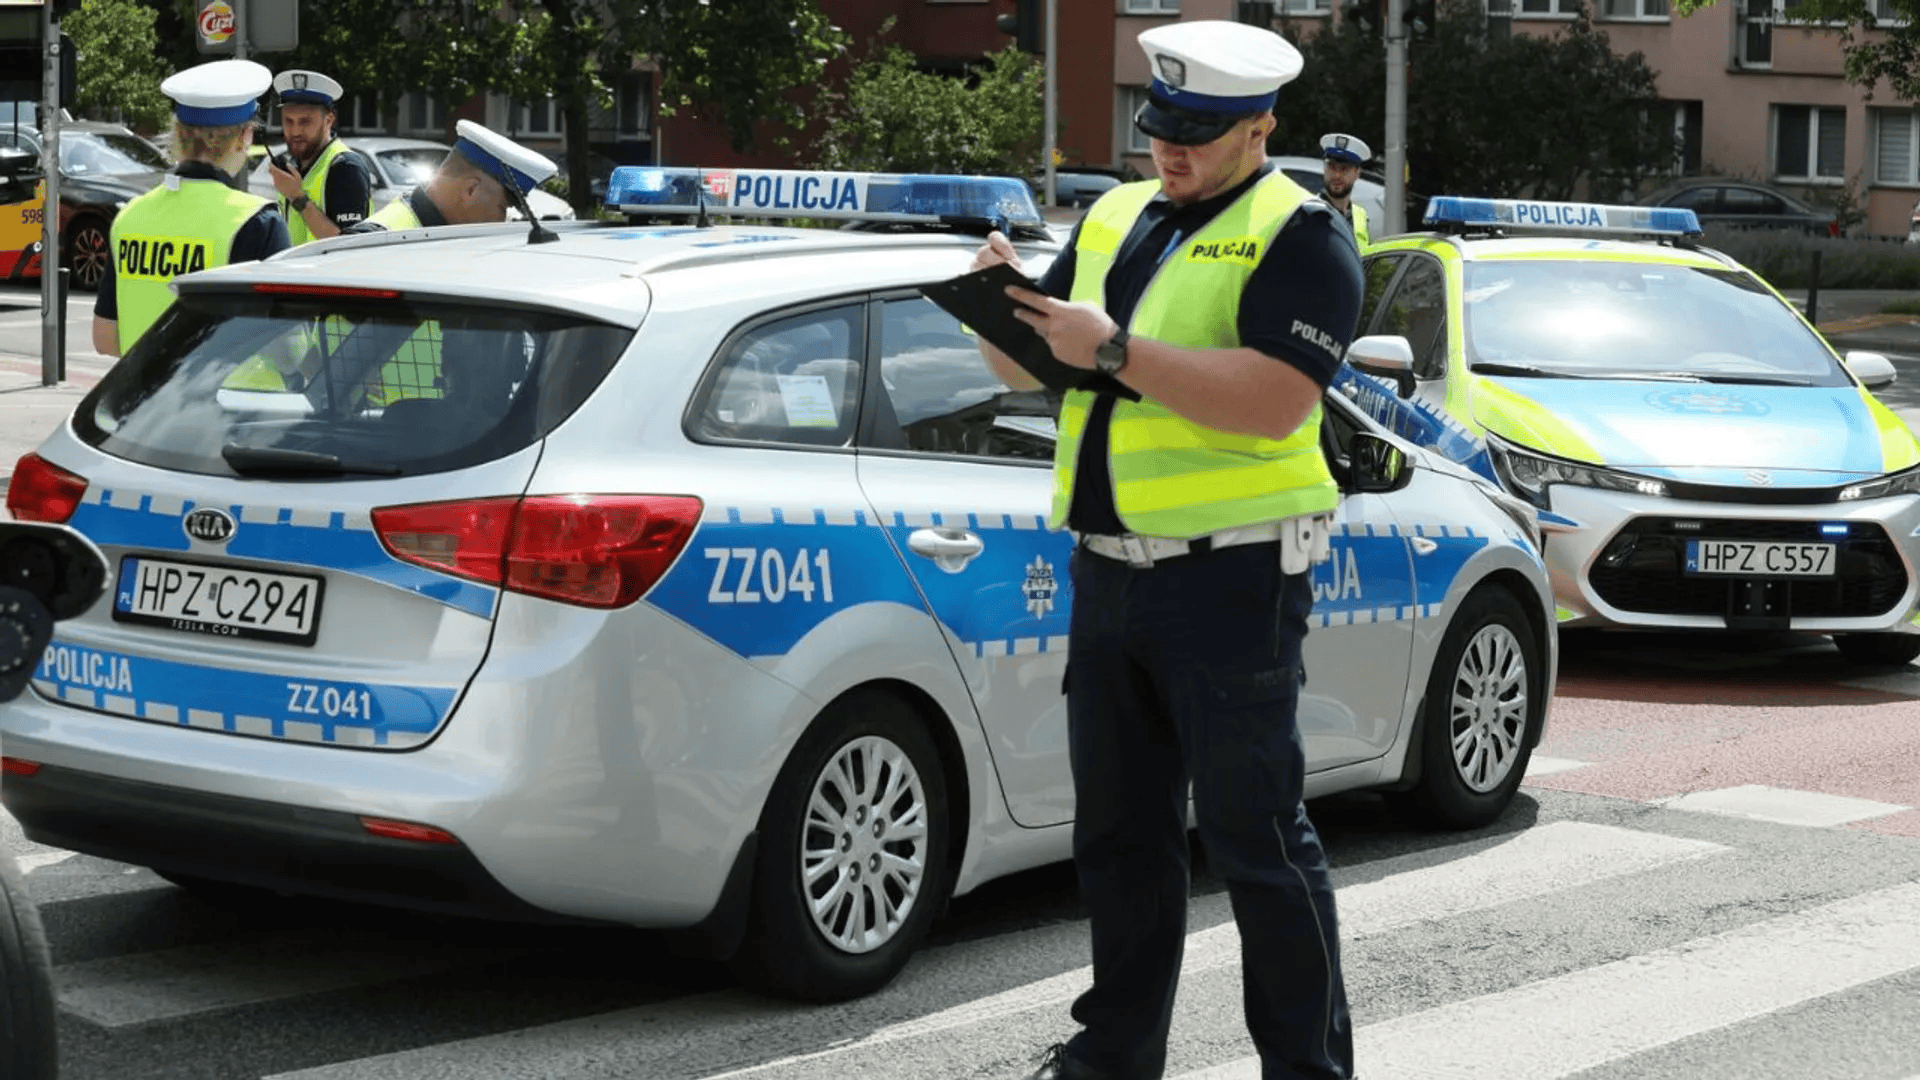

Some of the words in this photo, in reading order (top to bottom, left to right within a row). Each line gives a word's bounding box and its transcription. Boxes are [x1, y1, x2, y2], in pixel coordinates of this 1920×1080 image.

[734, 174, 858, 210] POLICJA
[1516, 203, 1603, 226] POLICJA
[119, 239, 205, 276] POLICJA
[1191, 241, 1257, 260] POLICJA
[189, 514, 225, 537] KIA
[1704, 543, 1756, 571] HPZ
[1766, 545, 1830, 573] C557
[703, 547, 834, 603] ZZ041
[119, 591, 131, 605] PL
[138, 566, 206, 616] HPZ
[215, 574, 309, 630] C294
[172, 618, 240, 636] TESLA.COM
[43, 645, 133, 693] POLICJA
